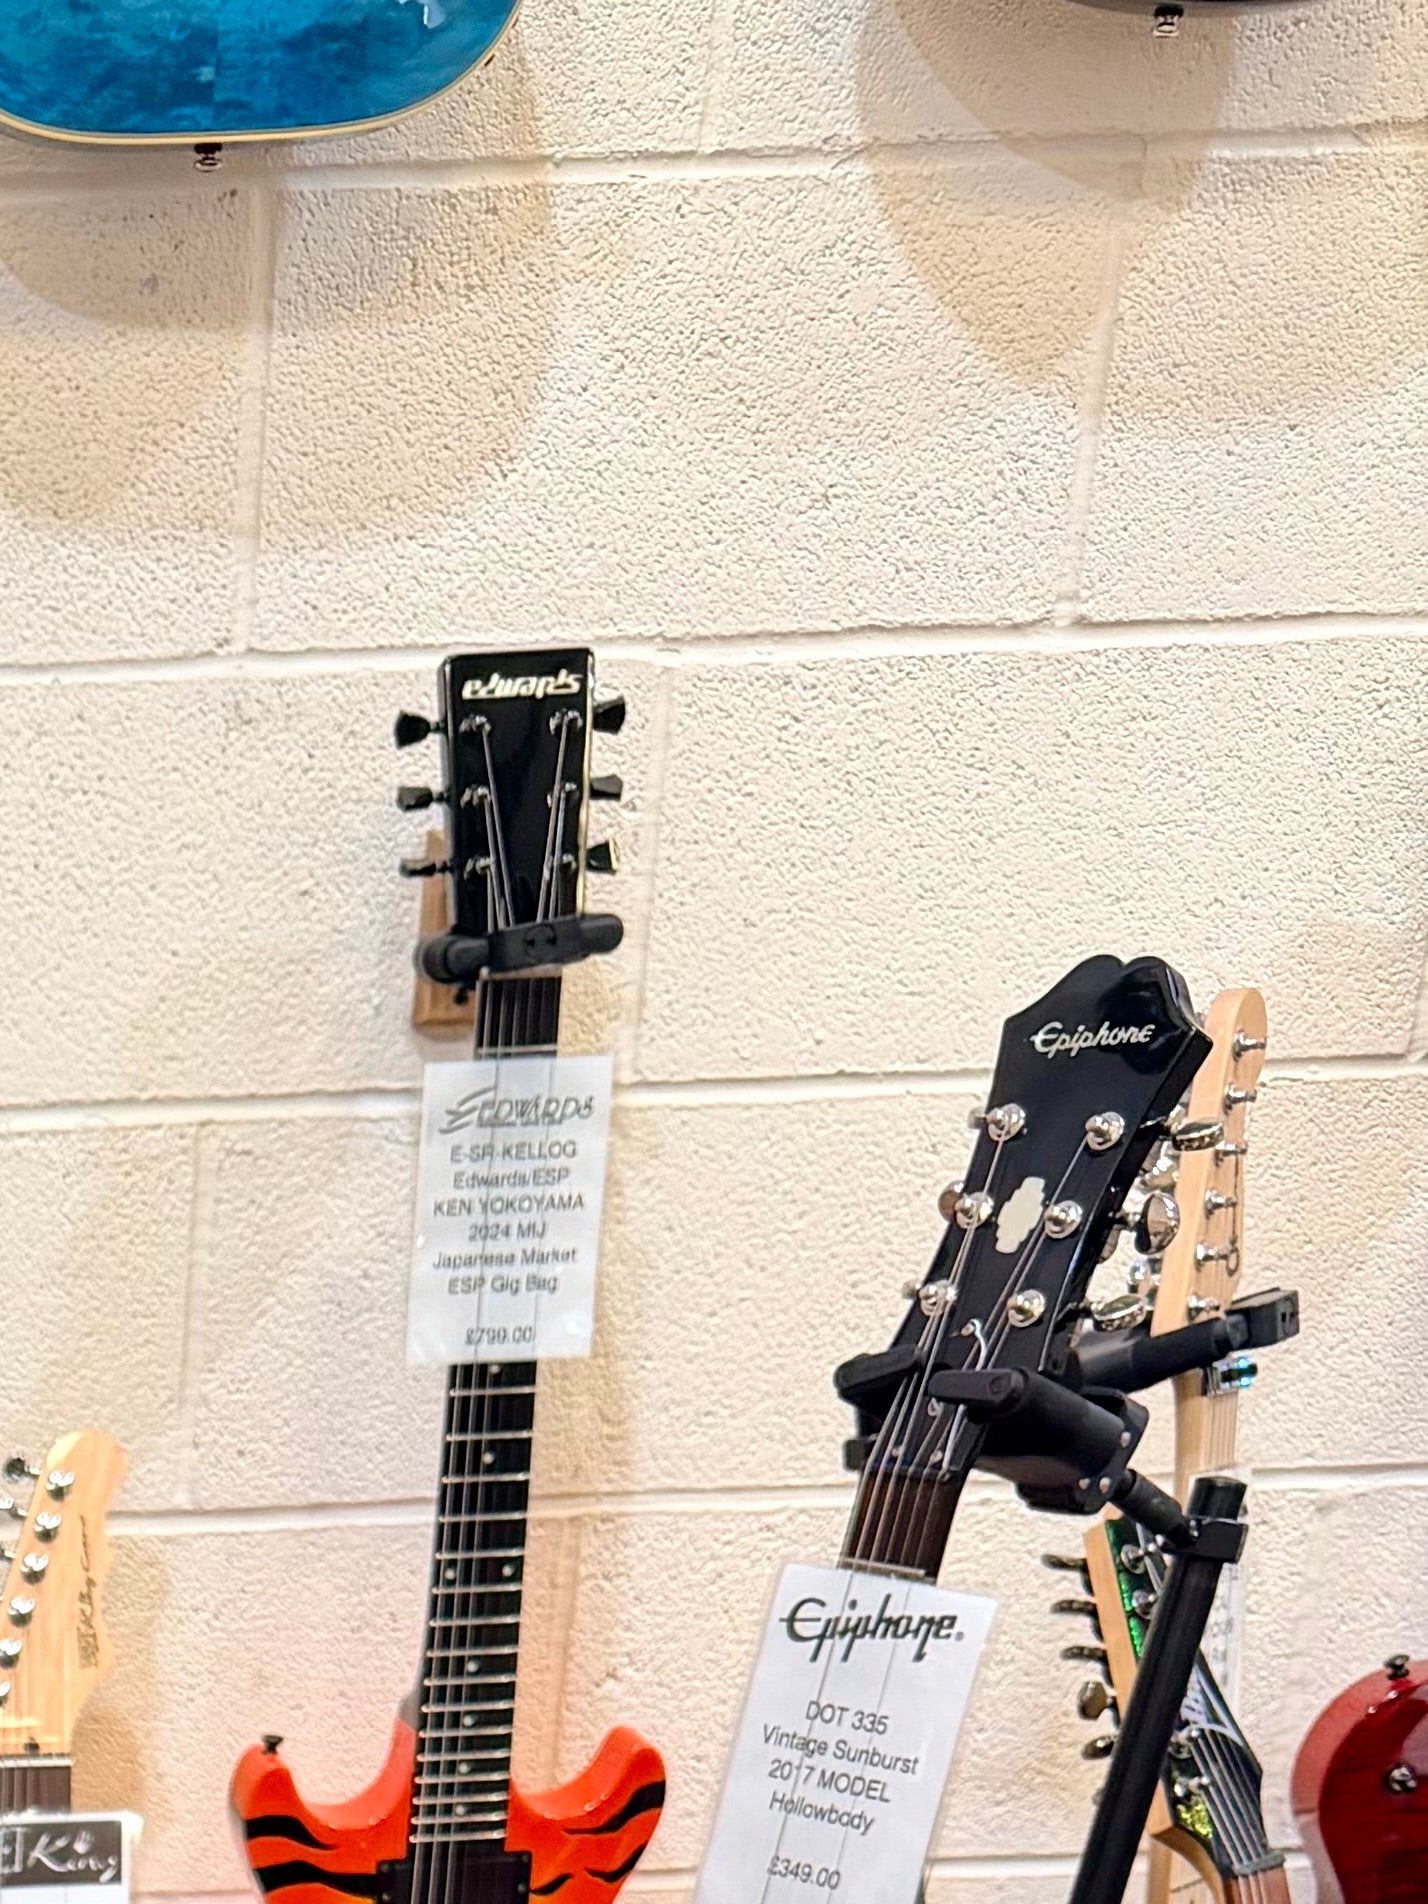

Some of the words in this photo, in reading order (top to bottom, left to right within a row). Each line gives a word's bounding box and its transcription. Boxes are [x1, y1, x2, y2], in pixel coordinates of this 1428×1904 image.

[1030, 1021, 1155, 1058] Epiphone
[433, 1198, 471, 1217] KEN
[479, 1193, 584, 1214] YOKOYAMA
[468, 1224, 509, 1242] 2024
[517, 1222, 544, 1240] MIJ
[432, 1250, 515, 1272] Japanese
[521, 1249, 577, 1266] Market
[447, 1277, 483, 1294] ESP
[490, 1276, 519, 1295] Gig
[526, 1274, 558, 1294] Bag
[806, 1701, 849, 1727] DOT
[851, 1711, 889, 1735] 335
[762, 1724, 828, 1759] Vintage
[832, 1739, 919, 1776] Sunburst
[768, 1760, 815, 1786] 2017
[816, 1769, 891, 1803] MODEL
[769, 1790, 875, 1837] Hollowbody
[767, 1855, 841, 1891] £349.00
